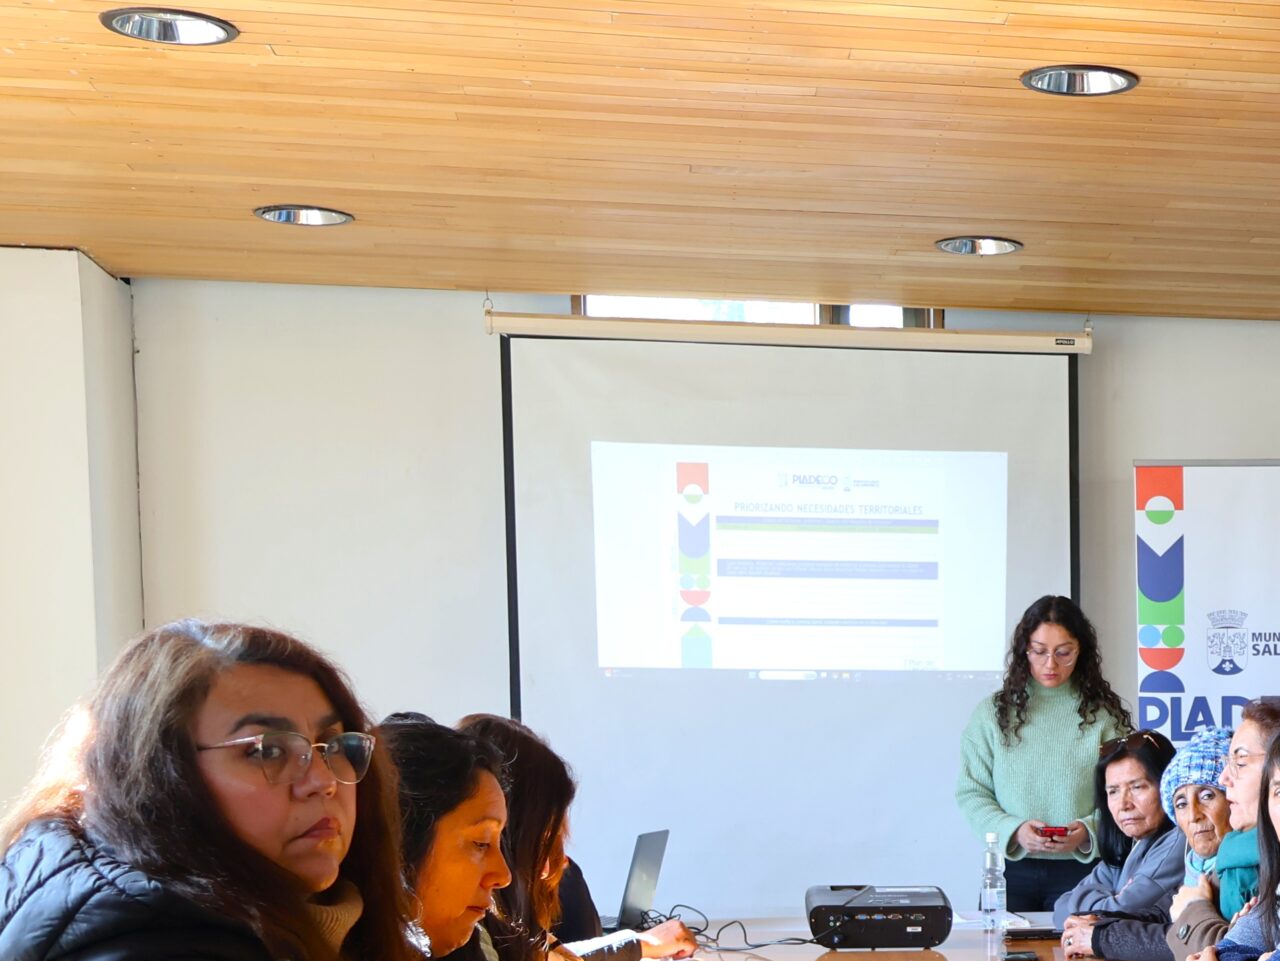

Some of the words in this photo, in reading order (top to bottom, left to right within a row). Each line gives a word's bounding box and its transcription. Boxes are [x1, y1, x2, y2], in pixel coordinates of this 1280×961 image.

[734, 502, 793, 513] PRIORIZANDO
[797, 504, 855, 514] NECESIDADES
[859, 505, 923, 515] TERRITORIALES
